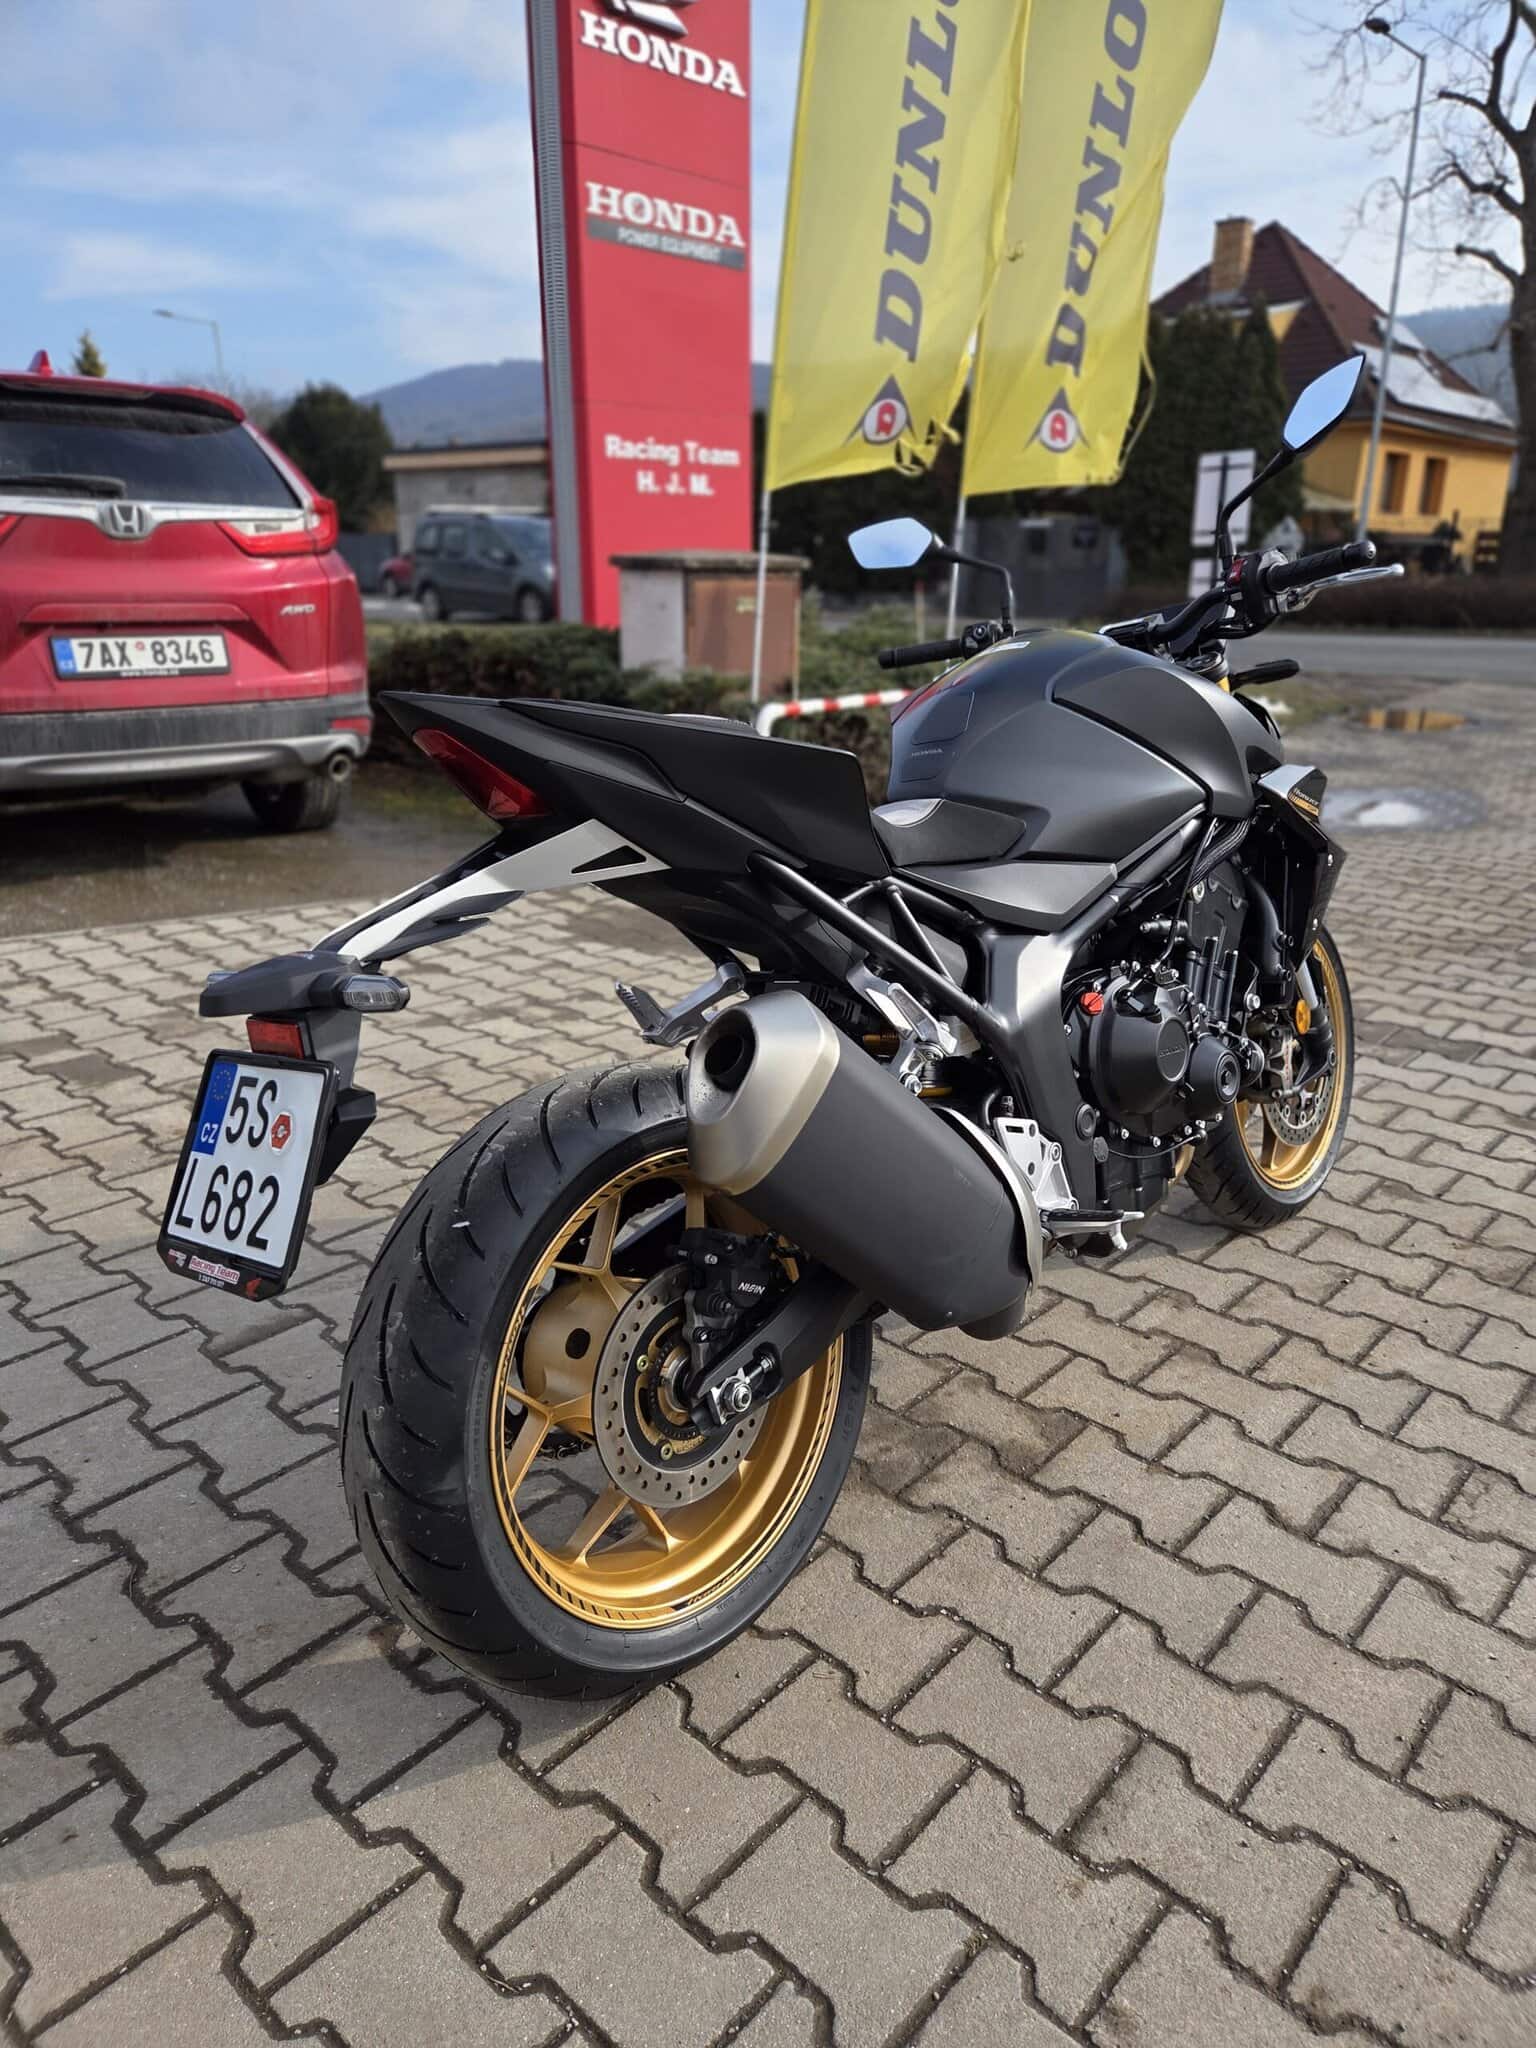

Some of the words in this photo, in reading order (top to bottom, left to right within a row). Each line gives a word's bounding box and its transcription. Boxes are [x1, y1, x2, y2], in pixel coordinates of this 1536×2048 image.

[579, 9, 746, 97] HONDA
[585, 181, 746, 248] HONDA
[873, 0, 959, 364] DUNL
[604, 434, 681, 467] Racing
[684, 441, 741, 467] Team
[77, 640, 132, 670] 7AX
[150, 639, 215, 666] 8346
[200, 1121, 219, 1144] CZ
[225, 1075, 278, 1148] 5S
[175, 1157, 280, 1251] L682
[217, 1265, 240, 1282] Team
